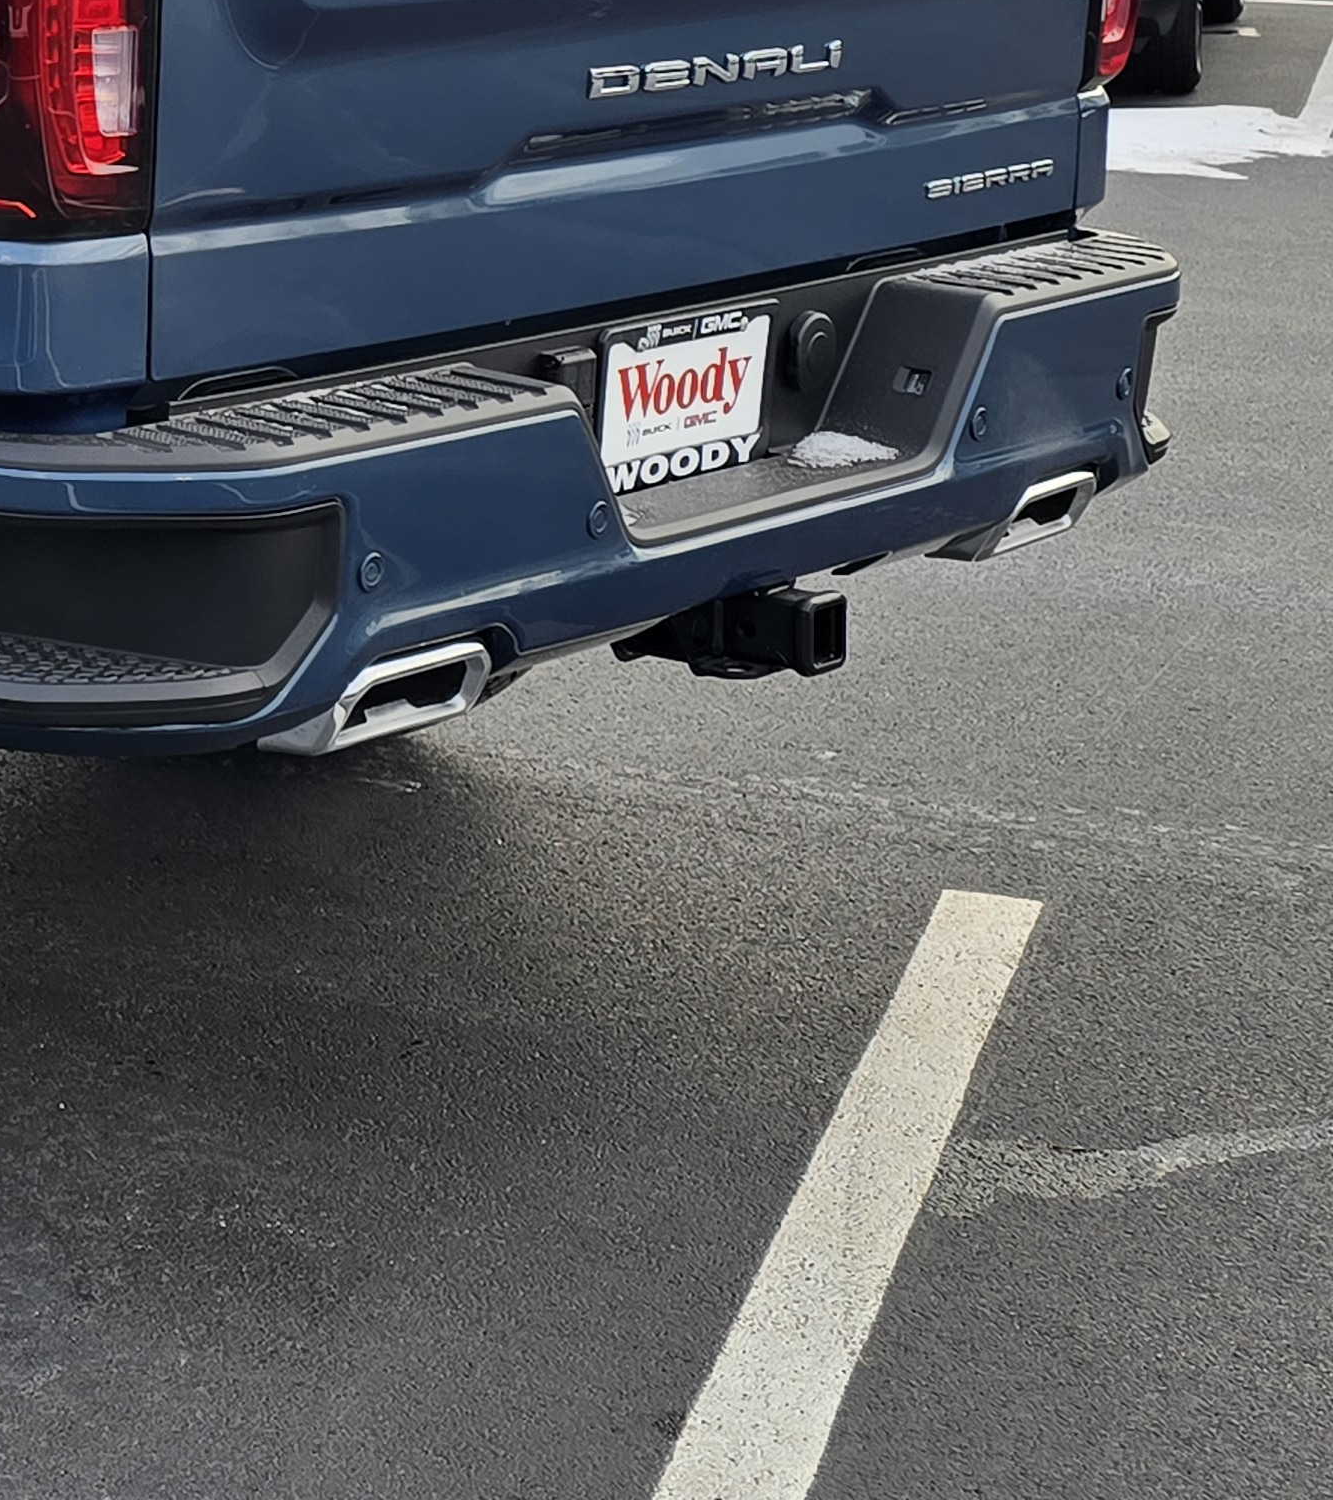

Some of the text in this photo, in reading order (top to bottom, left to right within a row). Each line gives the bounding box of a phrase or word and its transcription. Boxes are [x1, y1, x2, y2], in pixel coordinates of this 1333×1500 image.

[586, 39, 843, 99] DENALI
[924, 158, 1055, 200] SIERRA
[662, 311, 743, 338] BUICK GMC
[617, 347, 753, 422] Woody
[642, 410, 718, 436] BUICK GMC
[605, 433, 761, 494] WOODY
